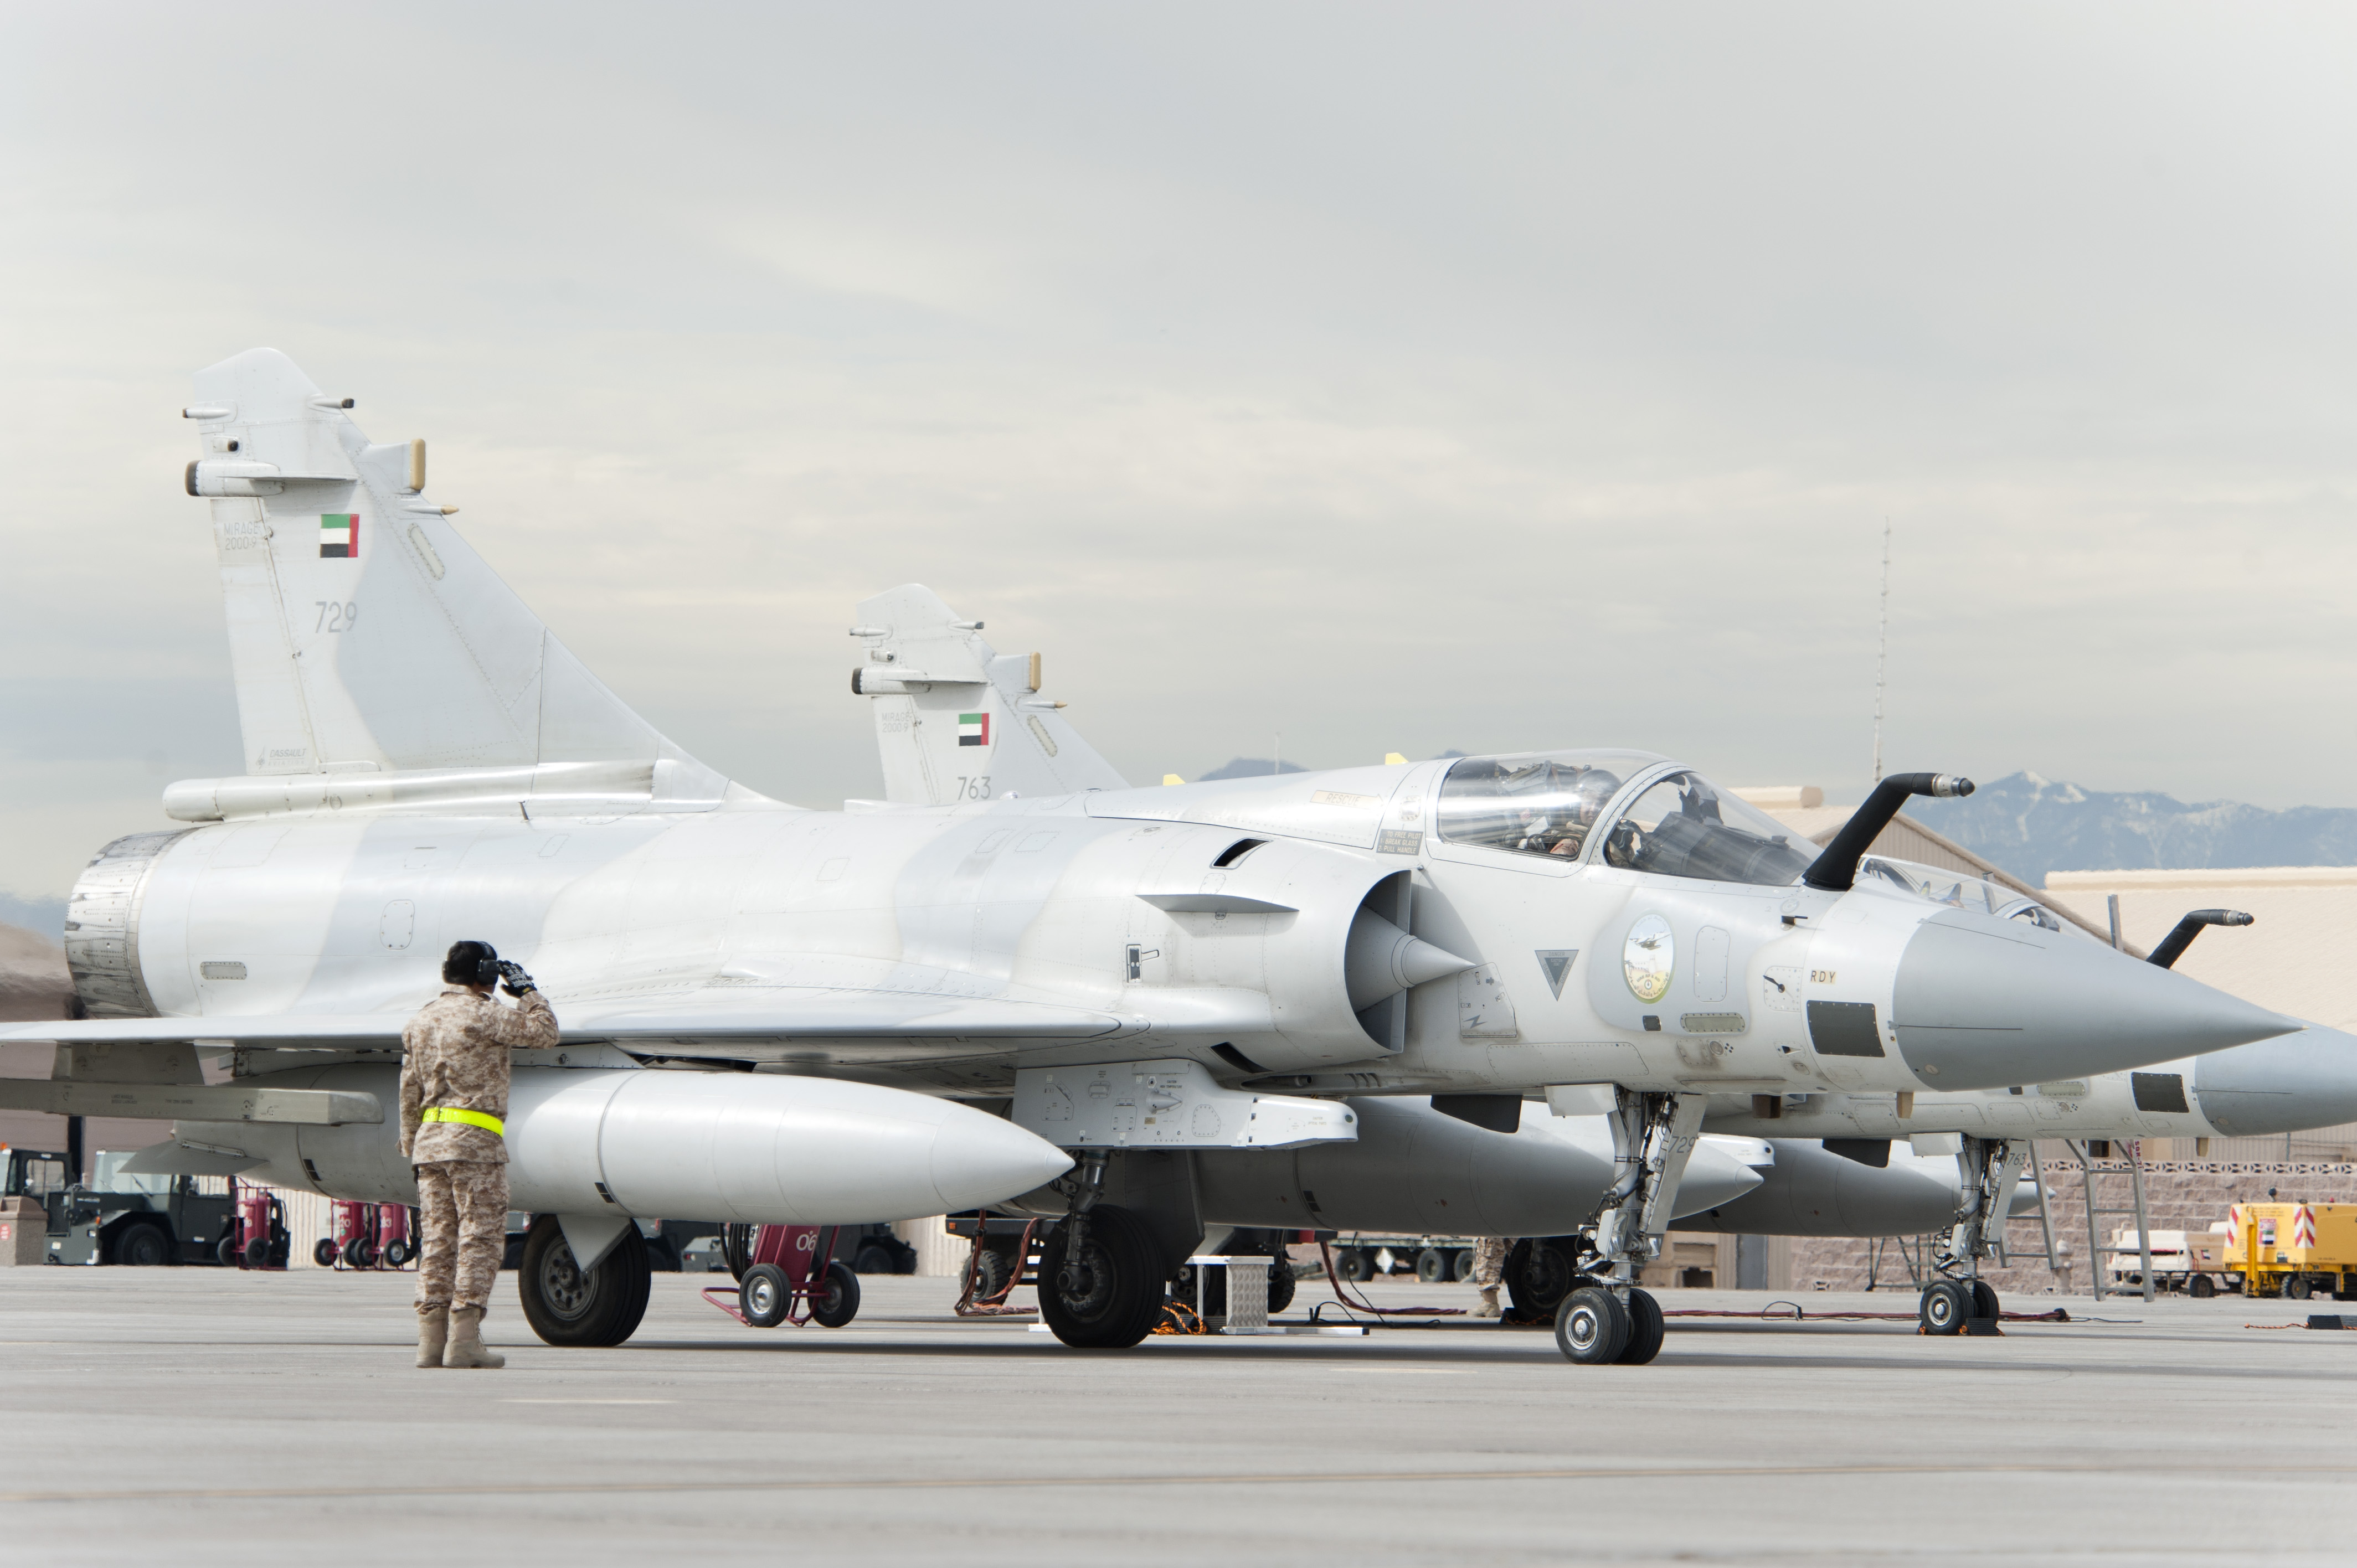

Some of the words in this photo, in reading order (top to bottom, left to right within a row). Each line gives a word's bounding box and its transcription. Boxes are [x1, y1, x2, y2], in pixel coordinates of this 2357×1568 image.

[224, 521, 258, 536] MIRAGE
[225, 536, 256, 550] 2000-9
[315, 601, 357, 633] 729
[882, 712, 909, 722] MIRAGE
[270, 749, 307, 758] DASSAULT
[958, 776, 990, 801] 763
[1325, 793, 1361, 806] RESCUE
[1543, 963, 1553, 983] DANGER
[1560, 963, 1571, 983] DANGER
[1810, 971, 1835, 983] RDY
[1669, 1136, 1696, 1153] 729
[2007, 1153, 2026, 1165] 763
